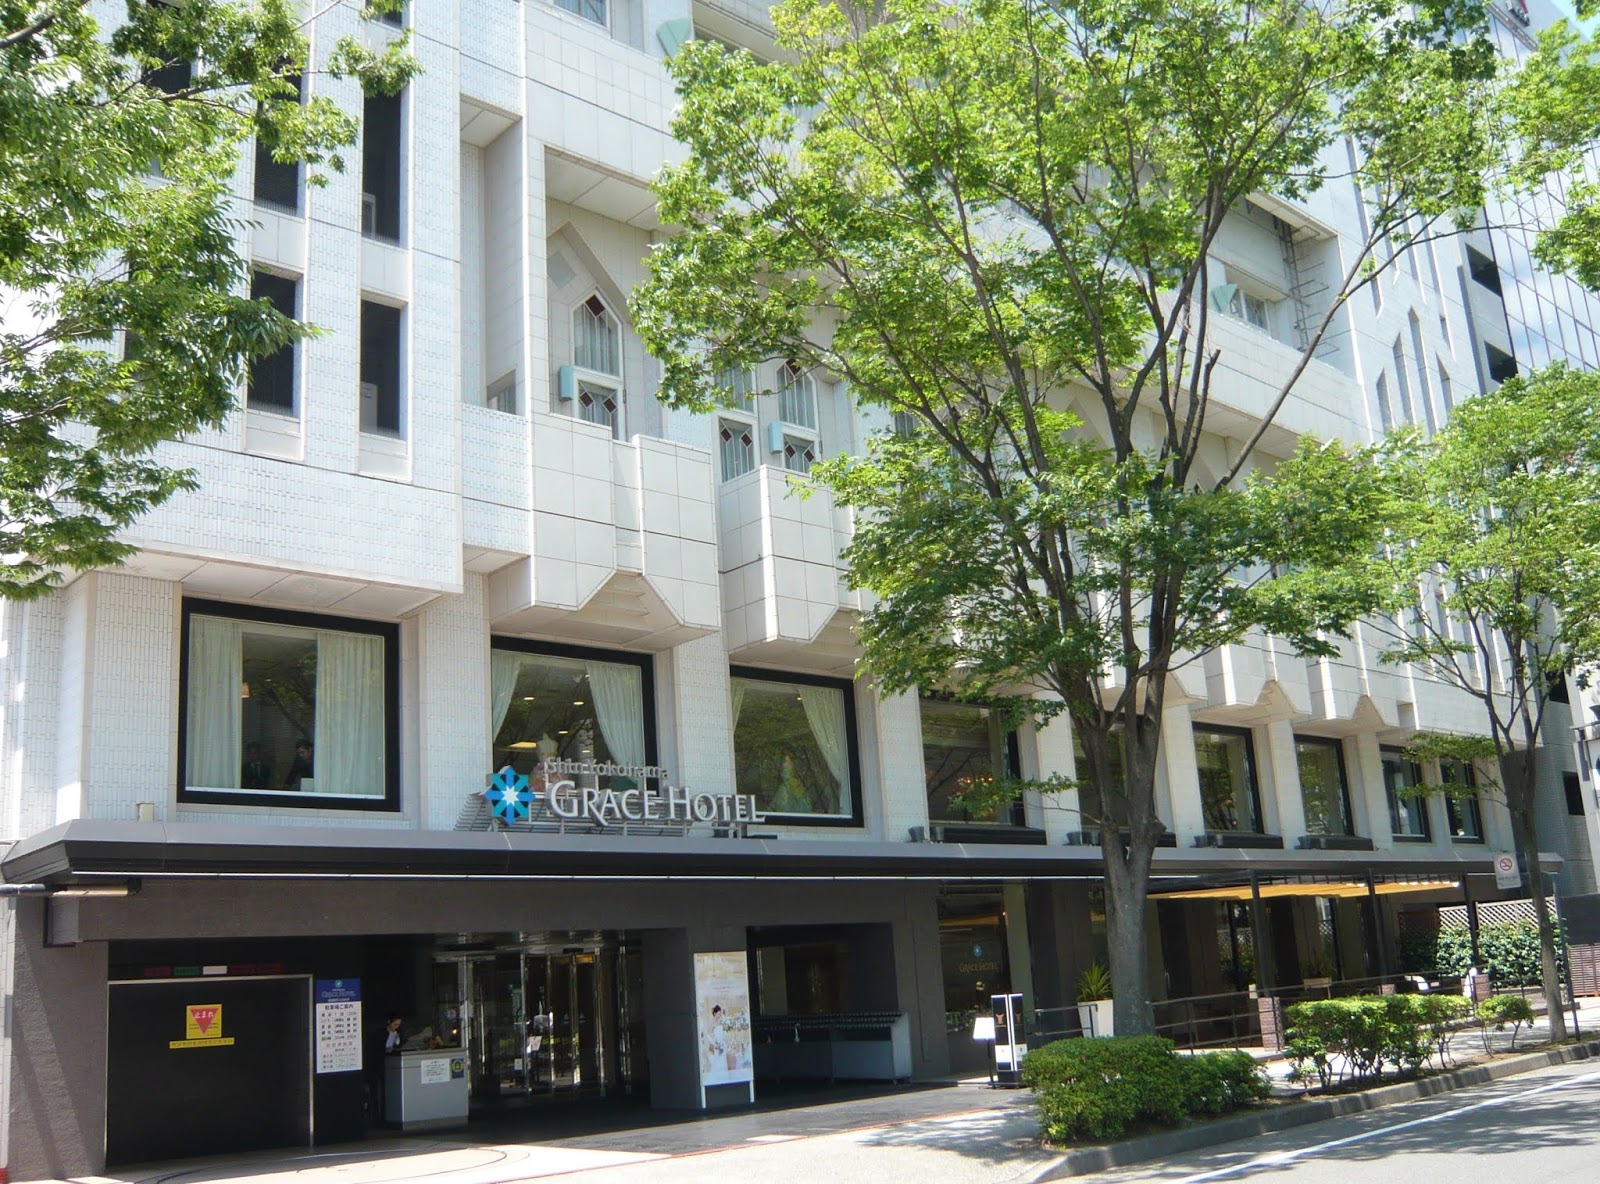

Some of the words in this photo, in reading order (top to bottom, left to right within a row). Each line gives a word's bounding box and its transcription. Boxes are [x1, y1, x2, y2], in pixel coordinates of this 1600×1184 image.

[550, 780, 661, 826] GRACE
[668, 785, 766, 822] HOTEL
[194, 1010, 214, 1019] 止まれ
